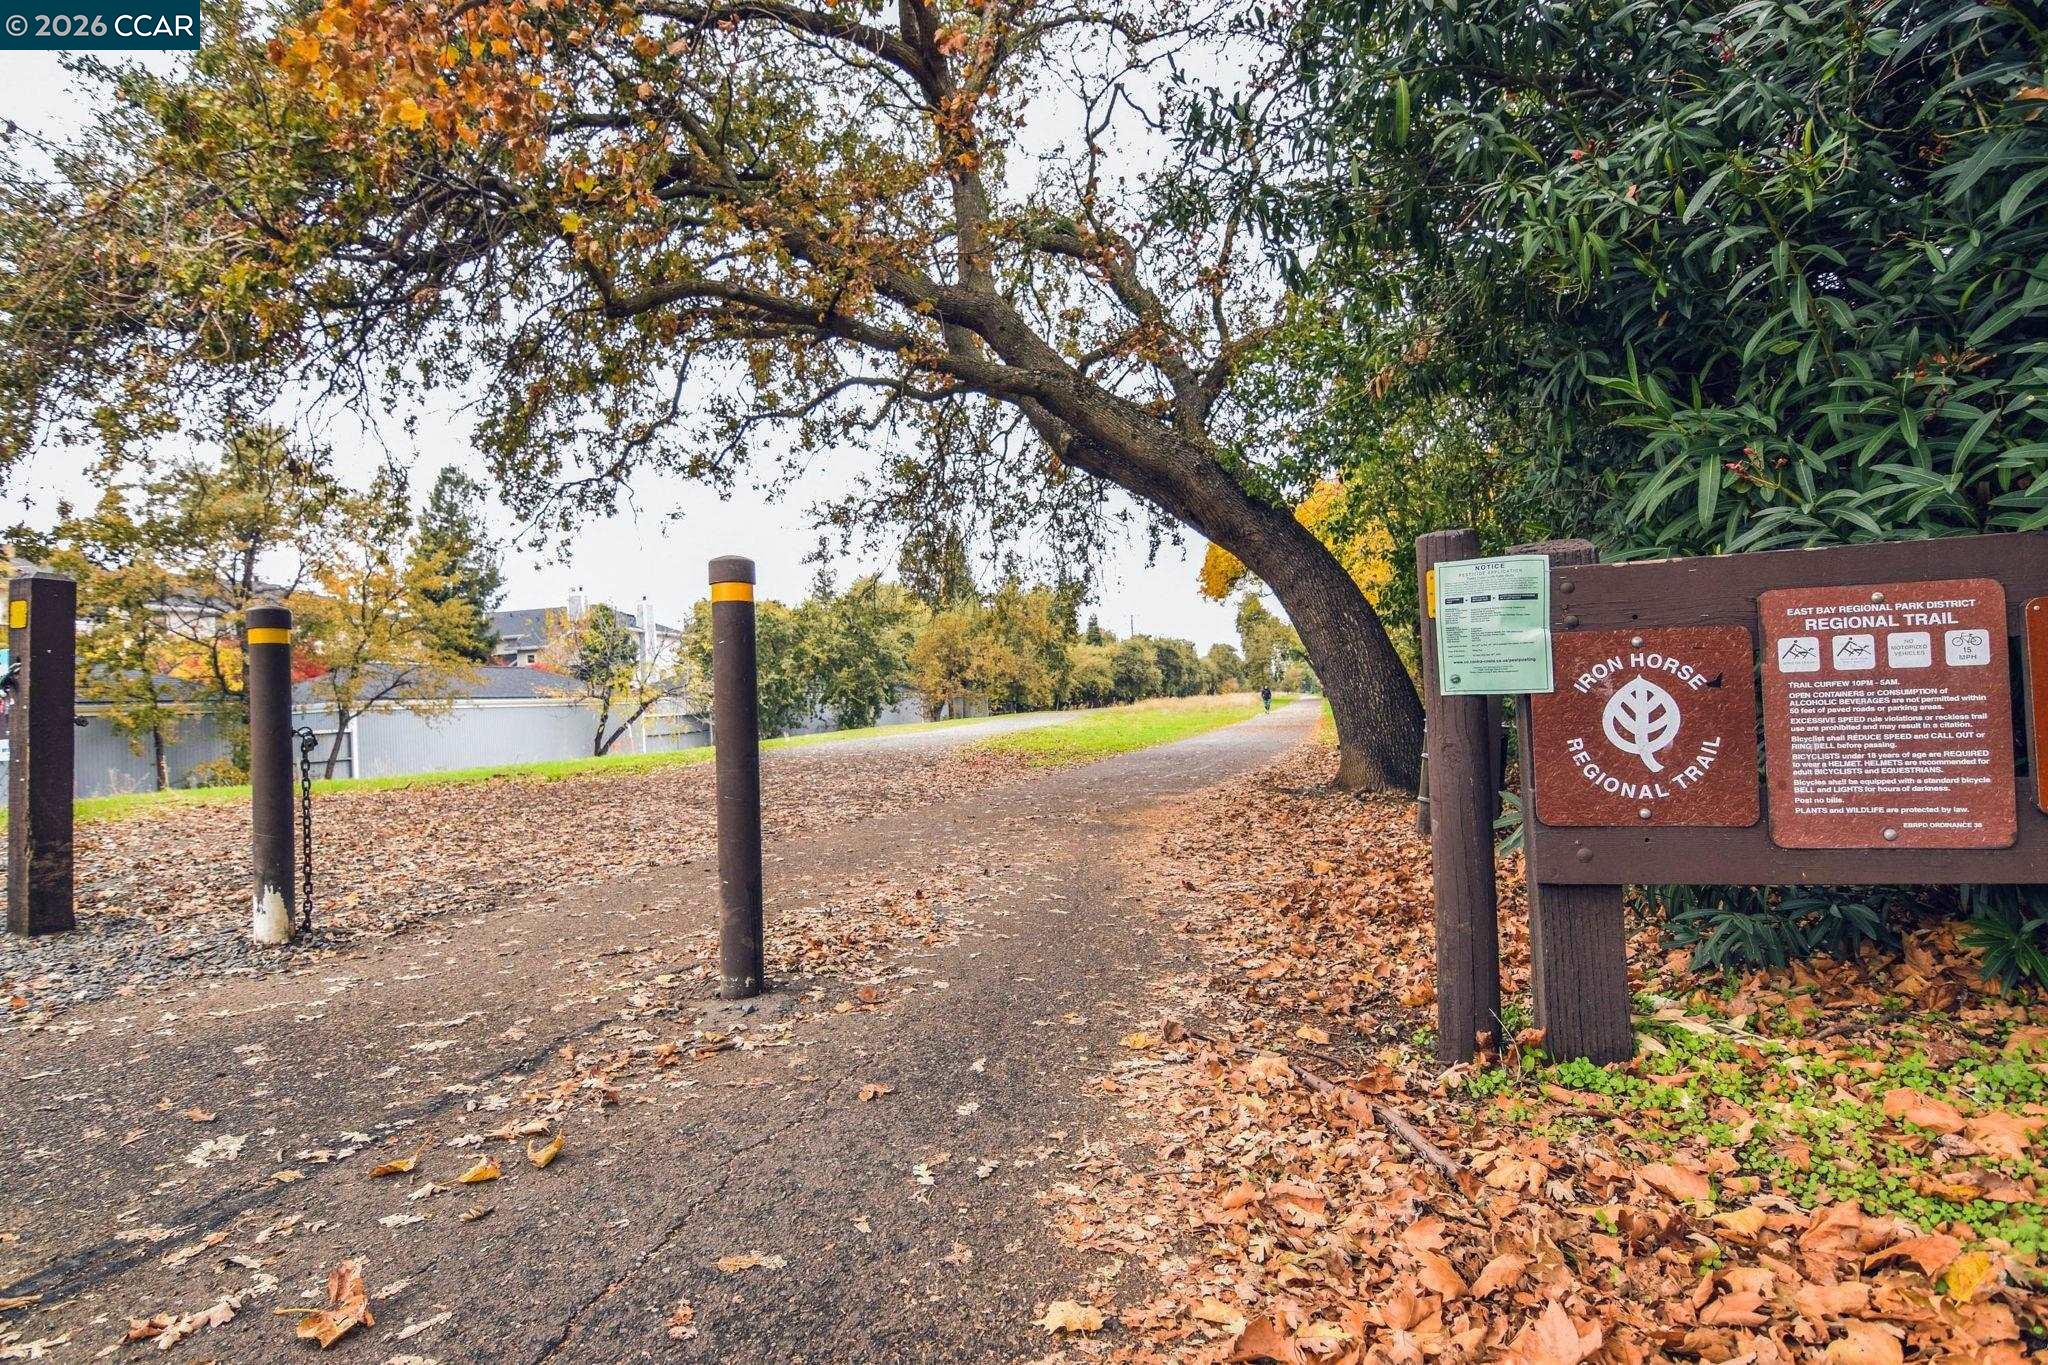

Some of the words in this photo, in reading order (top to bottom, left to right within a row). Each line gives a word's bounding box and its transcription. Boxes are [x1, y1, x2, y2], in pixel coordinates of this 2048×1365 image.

[1475, 563, 1505, 571] NOTICE
[1787, 607, 1813, 615] EAST
[1816, 606, 1836, 614] BAY
[1839, 604, 1892, 613] REGIONAL
[1895, 602, 1924, 610] PARK
[1927, 599, 1976, 609] DISTRICT
[1806, 615, 1899, 631] REGIONAL
[1903, 612, 1958, 626] TRAIL
[1574, 656, 1623, 694] IRON
[1630, 653, 1707, 690] HORSE
[1877, 688, 1937, 696] CONSUMPTION
[1827, 706, 1851, 714] paved
[1821, 724, 1861, 732] prohibited
[1791, 735, 1825, 743] Bicyclist
[1847, 733, 1881, 741] REDUCE
[1864, 741, 1897, 749] passing.
[1567, 738, 1670, 799] REGIONAL
[1672, 736, 1721, 790] TRAIL
[1881, 766, 1943, 774] EQUESTRIANS.
[1901, 806, 1939, 814] protected
